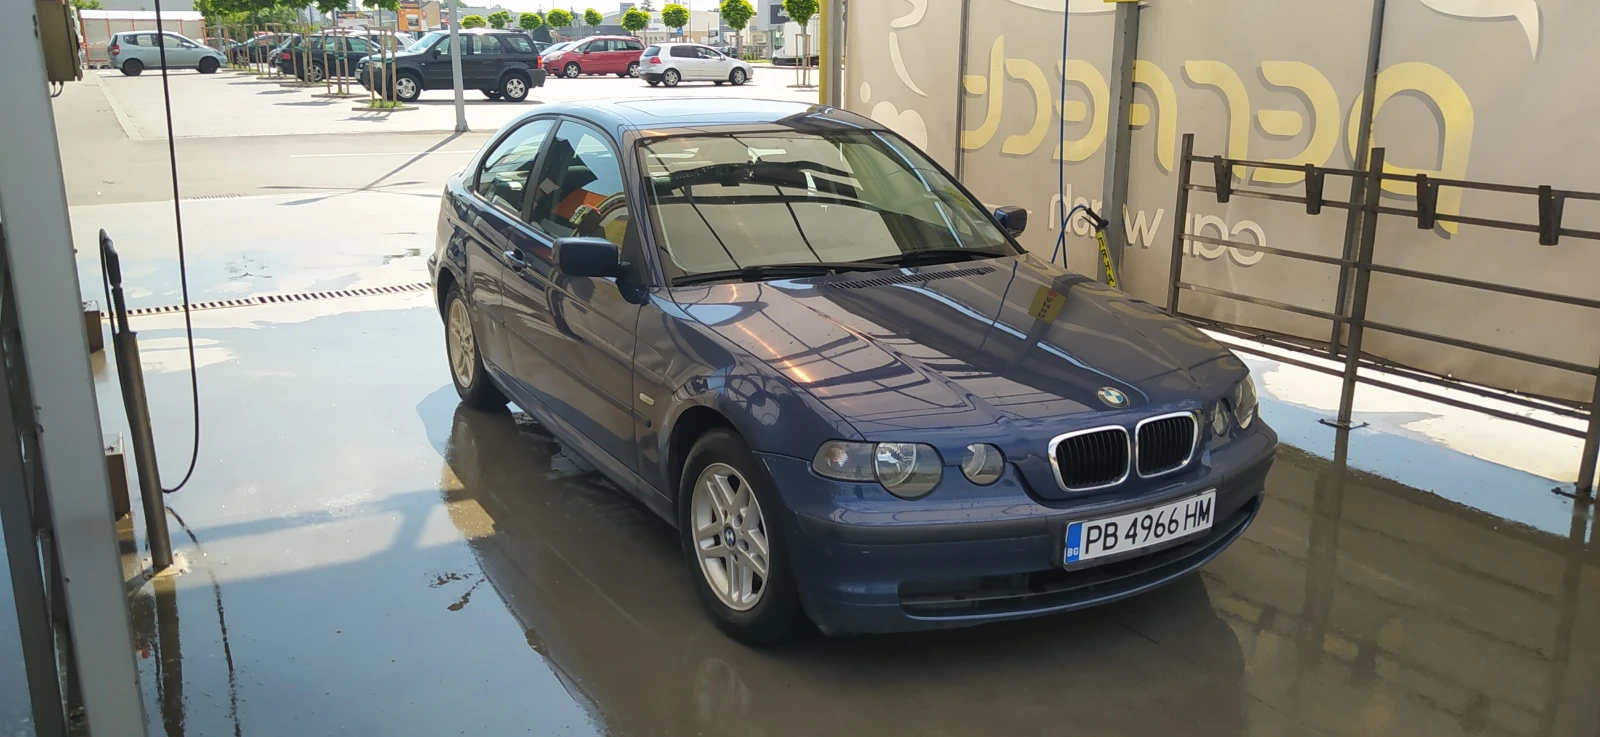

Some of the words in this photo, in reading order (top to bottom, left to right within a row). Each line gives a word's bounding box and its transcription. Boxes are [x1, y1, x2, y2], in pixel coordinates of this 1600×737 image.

[1084, 522, 1119, 554] PB
[1124, 506, 1179, 545] 4966
[1183, 497, 1212, 531] HM
[1067, 547, 1079, 557] BG
